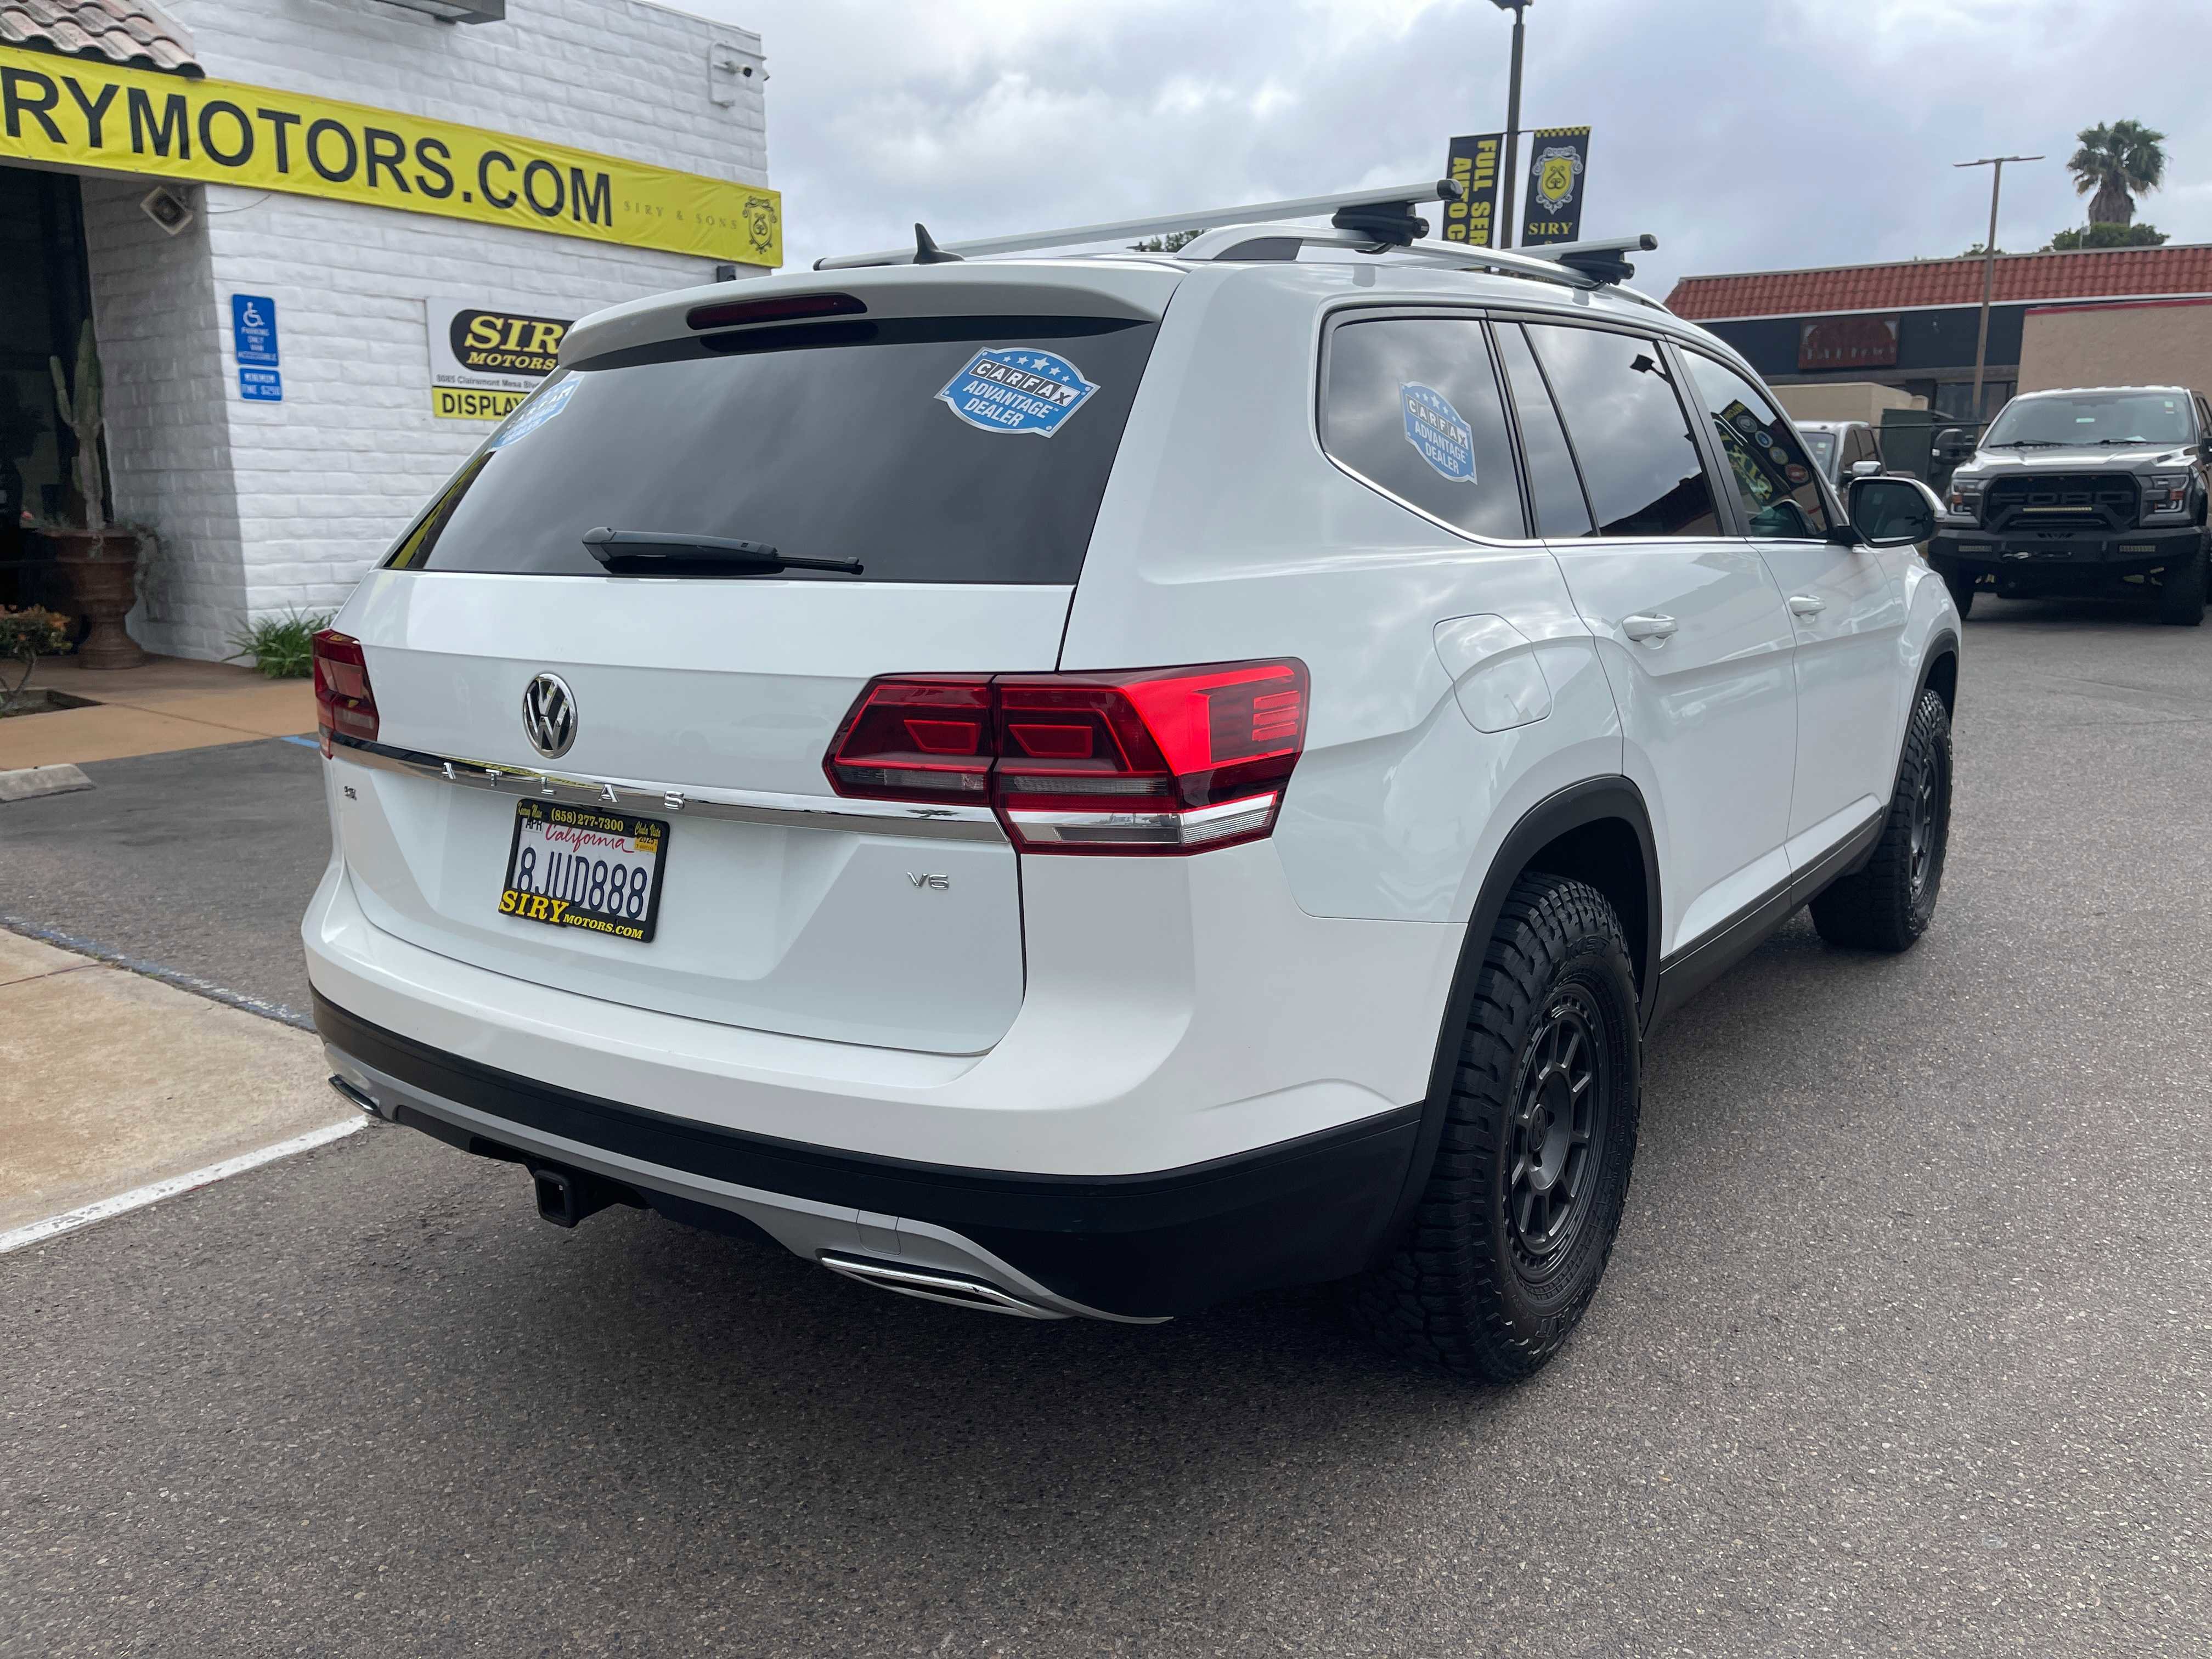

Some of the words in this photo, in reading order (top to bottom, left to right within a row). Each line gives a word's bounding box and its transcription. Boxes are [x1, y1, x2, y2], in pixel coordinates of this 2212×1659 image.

[1, 66, 612, 227] RYMOTORS.COM
[1473, 140, 1497, 191] FULL
[624, 201, 663, 216] SIRY
[676, 211, 683, 221] &
[696, 213, 737, 229] SONS
[1447, 224, 1466, 240] C
[1469, 201, 1491, 247] SER
[1528, 222, 1572, 235] SIRY
[464, 315, 567, 354] SIR
[466, 351, 556, 370] MOTORS
[962, 380, 1053, 419] ADVANTAGE
[977, 363, 1071, 404] CARFAX
[963, 398, 1024, 427] DEALER
[1408, 399, 1468, 448] CARFAX
[1414, 421, 1466, 464] ADVANTAGE
[1425, 442, 1459, 475] DEALER
[442, 761, 686, 811] ATLAS
[545, 823, 635, 853] California
[551, 807, 577, 825] (858)
[577, 814, 624, 832] 277-7300
[517, 847, 647, 918] 8JUD888
[906, 871, 949, 890] V6
[500, 889, 569, 923] SIRY
[563, 913, 644, 940] MOTORS.COM
